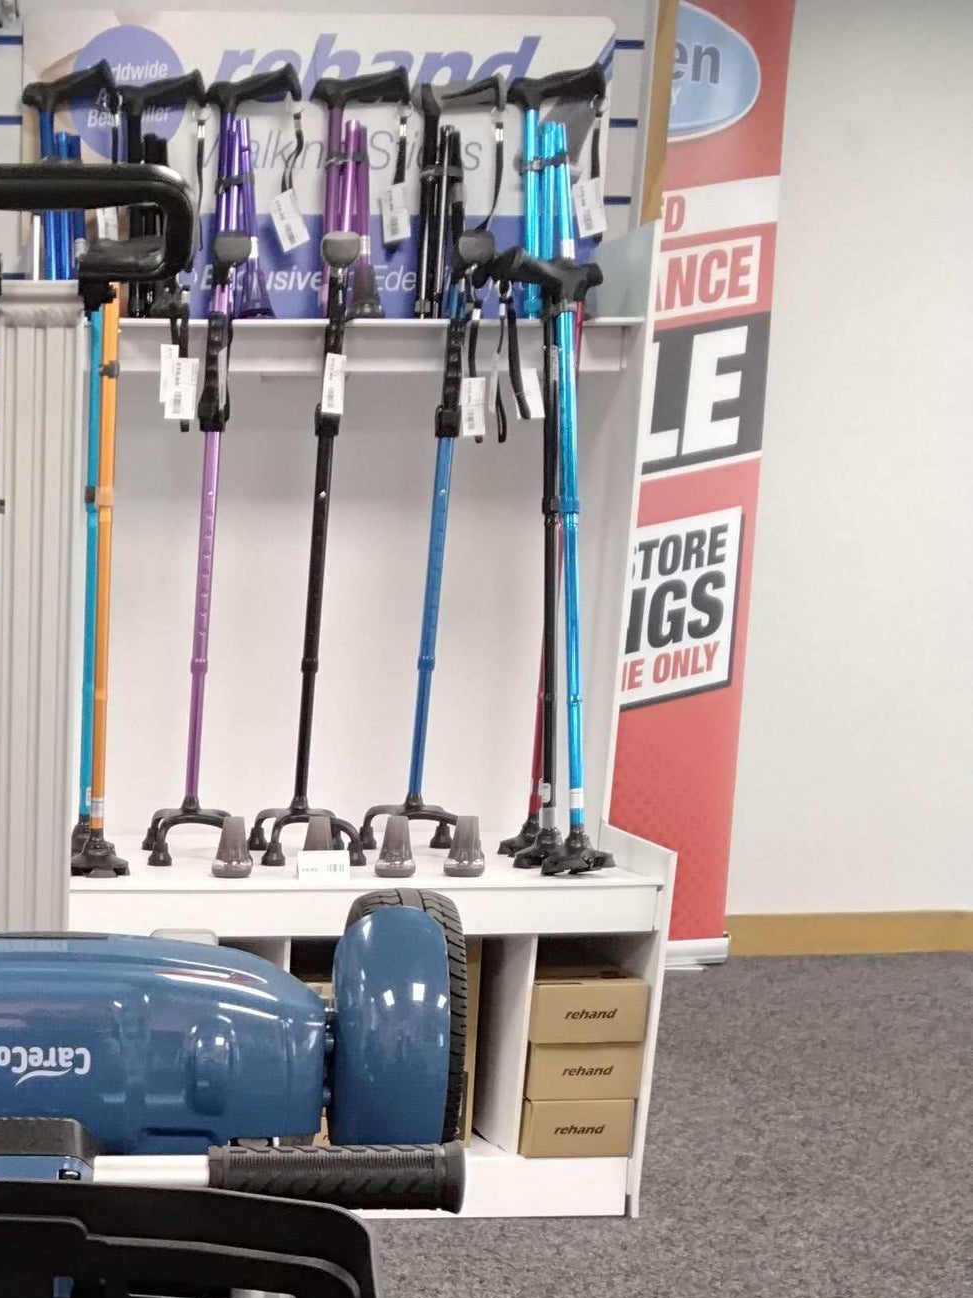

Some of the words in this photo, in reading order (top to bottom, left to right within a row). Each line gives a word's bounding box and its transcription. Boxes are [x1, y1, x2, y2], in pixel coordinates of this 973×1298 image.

[110, 60, 168, 81] ldwide
[655, 244, 754, 312] NCE
[632, 523, 729, 581] TORE
[652, 641, 721, 684] ONLY
[564, 1008, 618, 1020] rehand
[561, 1065, 614, 1077] rehand
[553, 1124, 607, 1136] rehand
